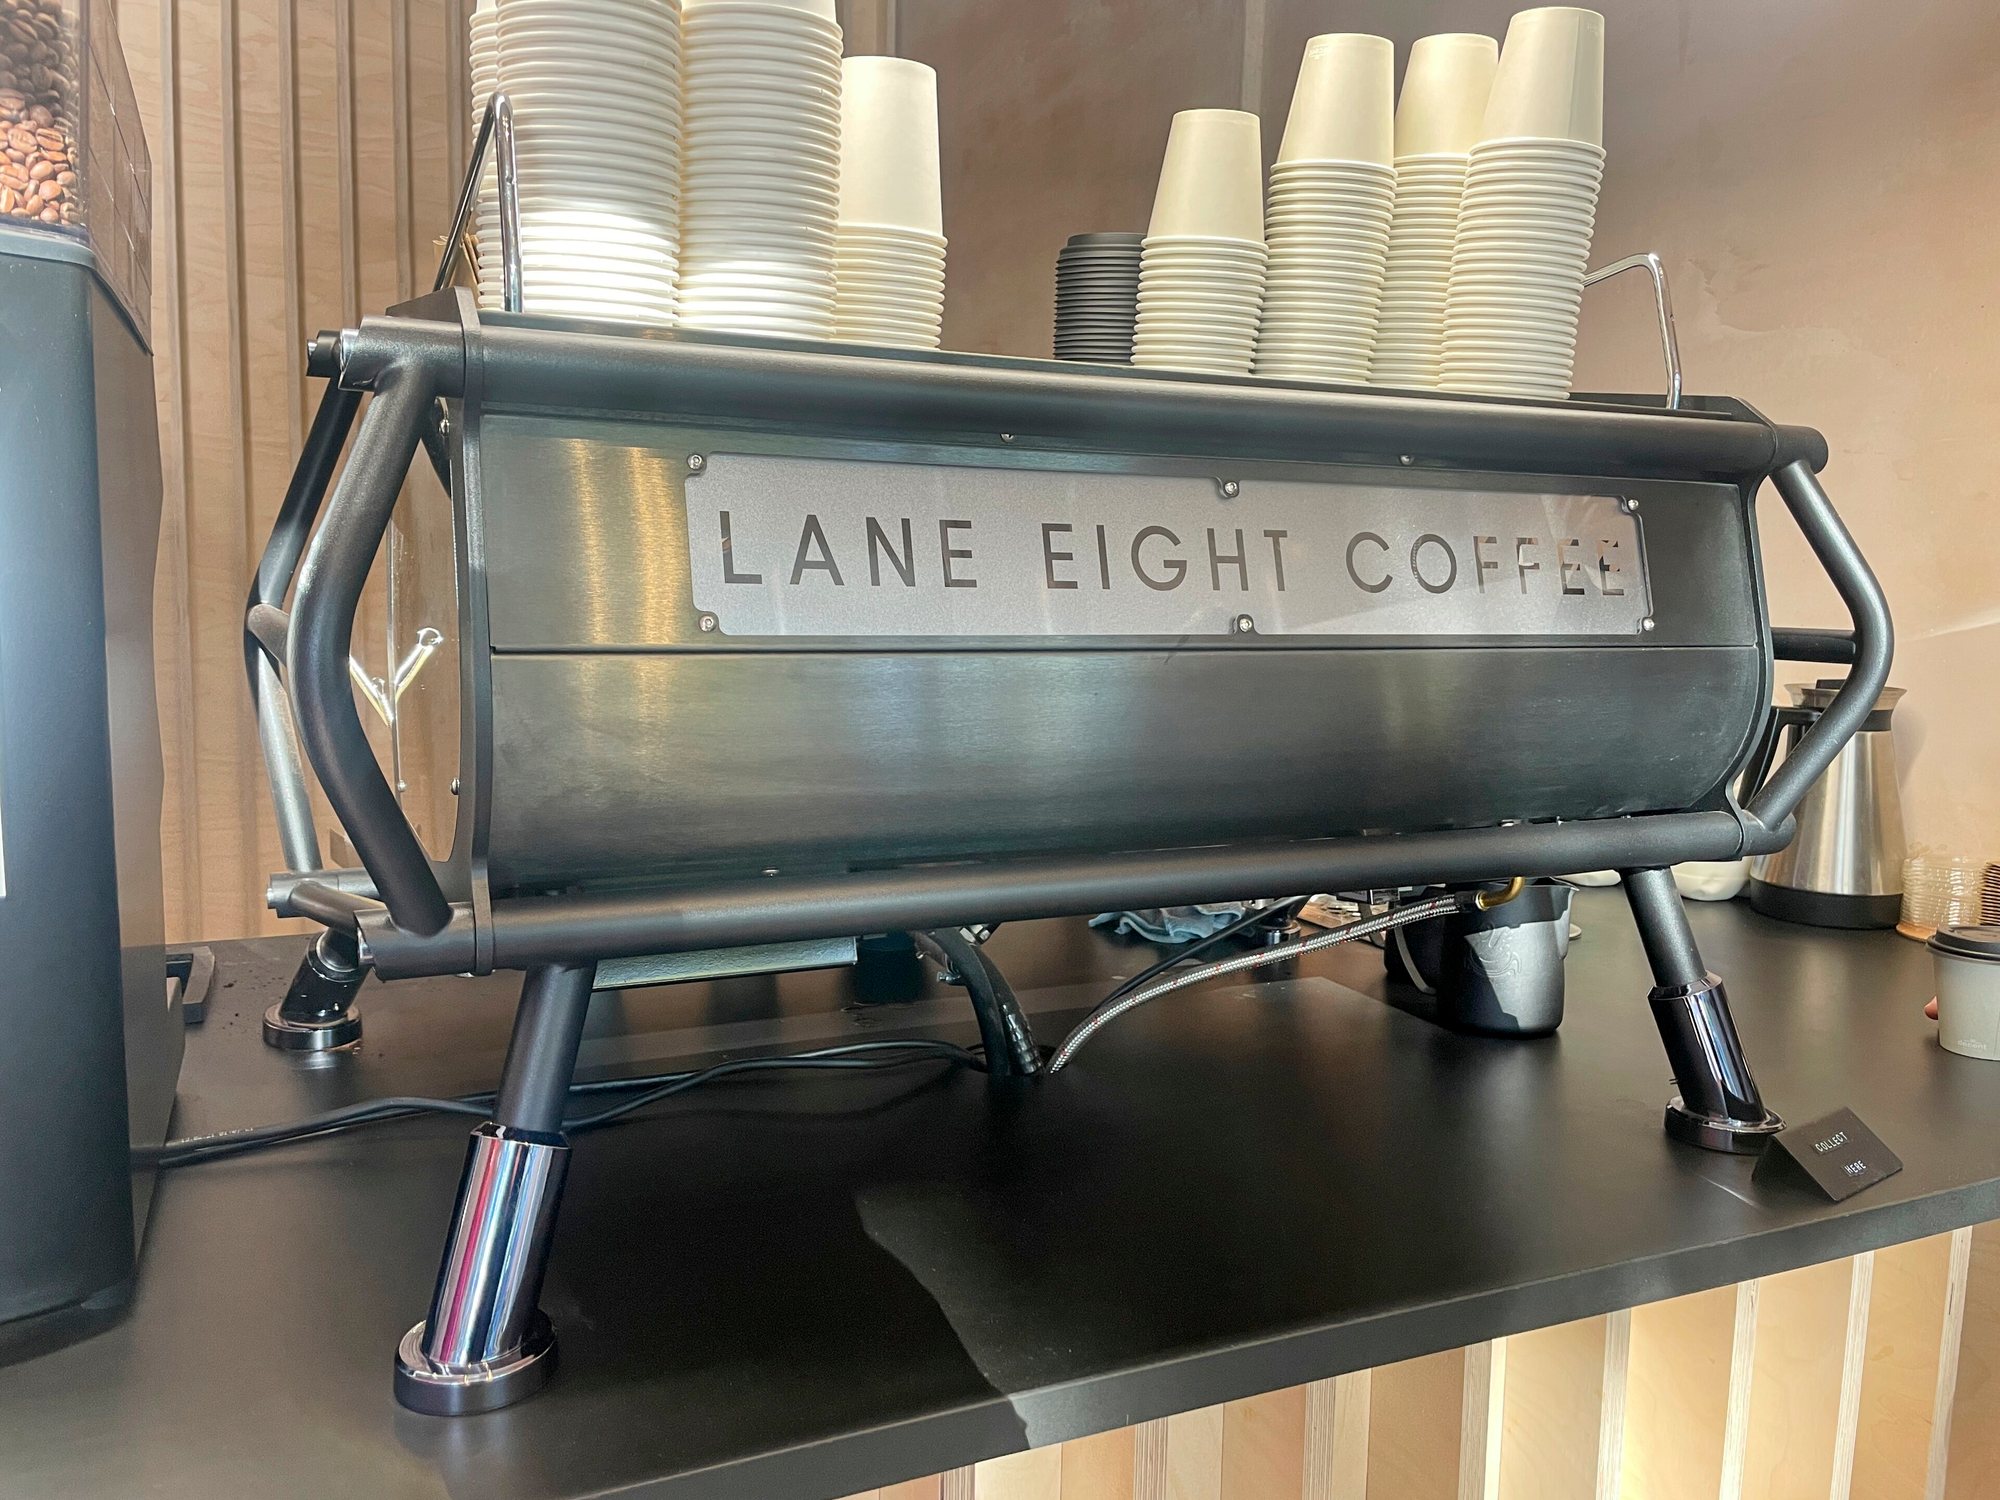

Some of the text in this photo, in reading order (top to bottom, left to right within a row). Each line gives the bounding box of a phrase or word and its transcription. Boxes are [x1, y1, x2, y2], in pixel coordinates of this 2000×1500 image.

[719, 510, 1625, 596] LANE EIGHT COFFEE
[1814, 1131, 1848, 1152] COLLECT
[1844, 1160, 1867, 1174] HERE
